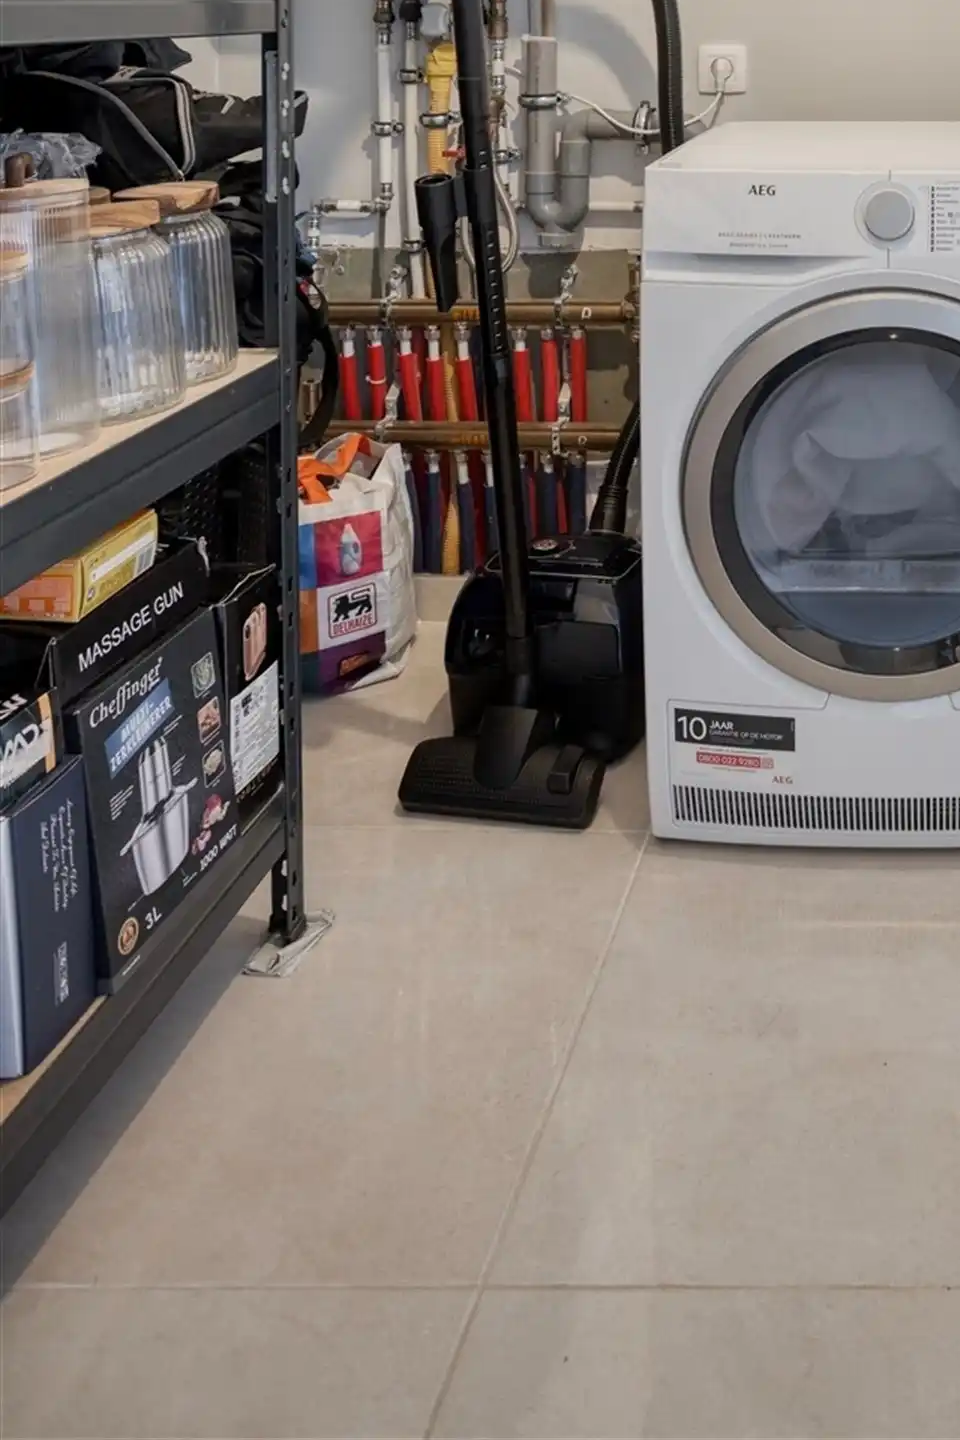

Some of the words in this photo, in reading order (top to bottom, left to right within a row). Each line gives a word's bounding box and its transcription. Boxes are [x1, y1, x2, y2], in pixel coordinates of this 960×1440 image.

[747, 184, 777, 197] AEG
[78, 605, 153, 673] MASSAGE
[153, 581, 185, 616] GUN
[332, 613, 374, 636] DELHAIZE
[89, 658, 164, 728] Cheffinger
[677, 715, 708, 741] 10
[709, 720, 735, 730] JAAR
[772, 775, 794, 785] AEG
[199, 844, 219, 872] 1000
[144, 906, 163, 930] 3L
